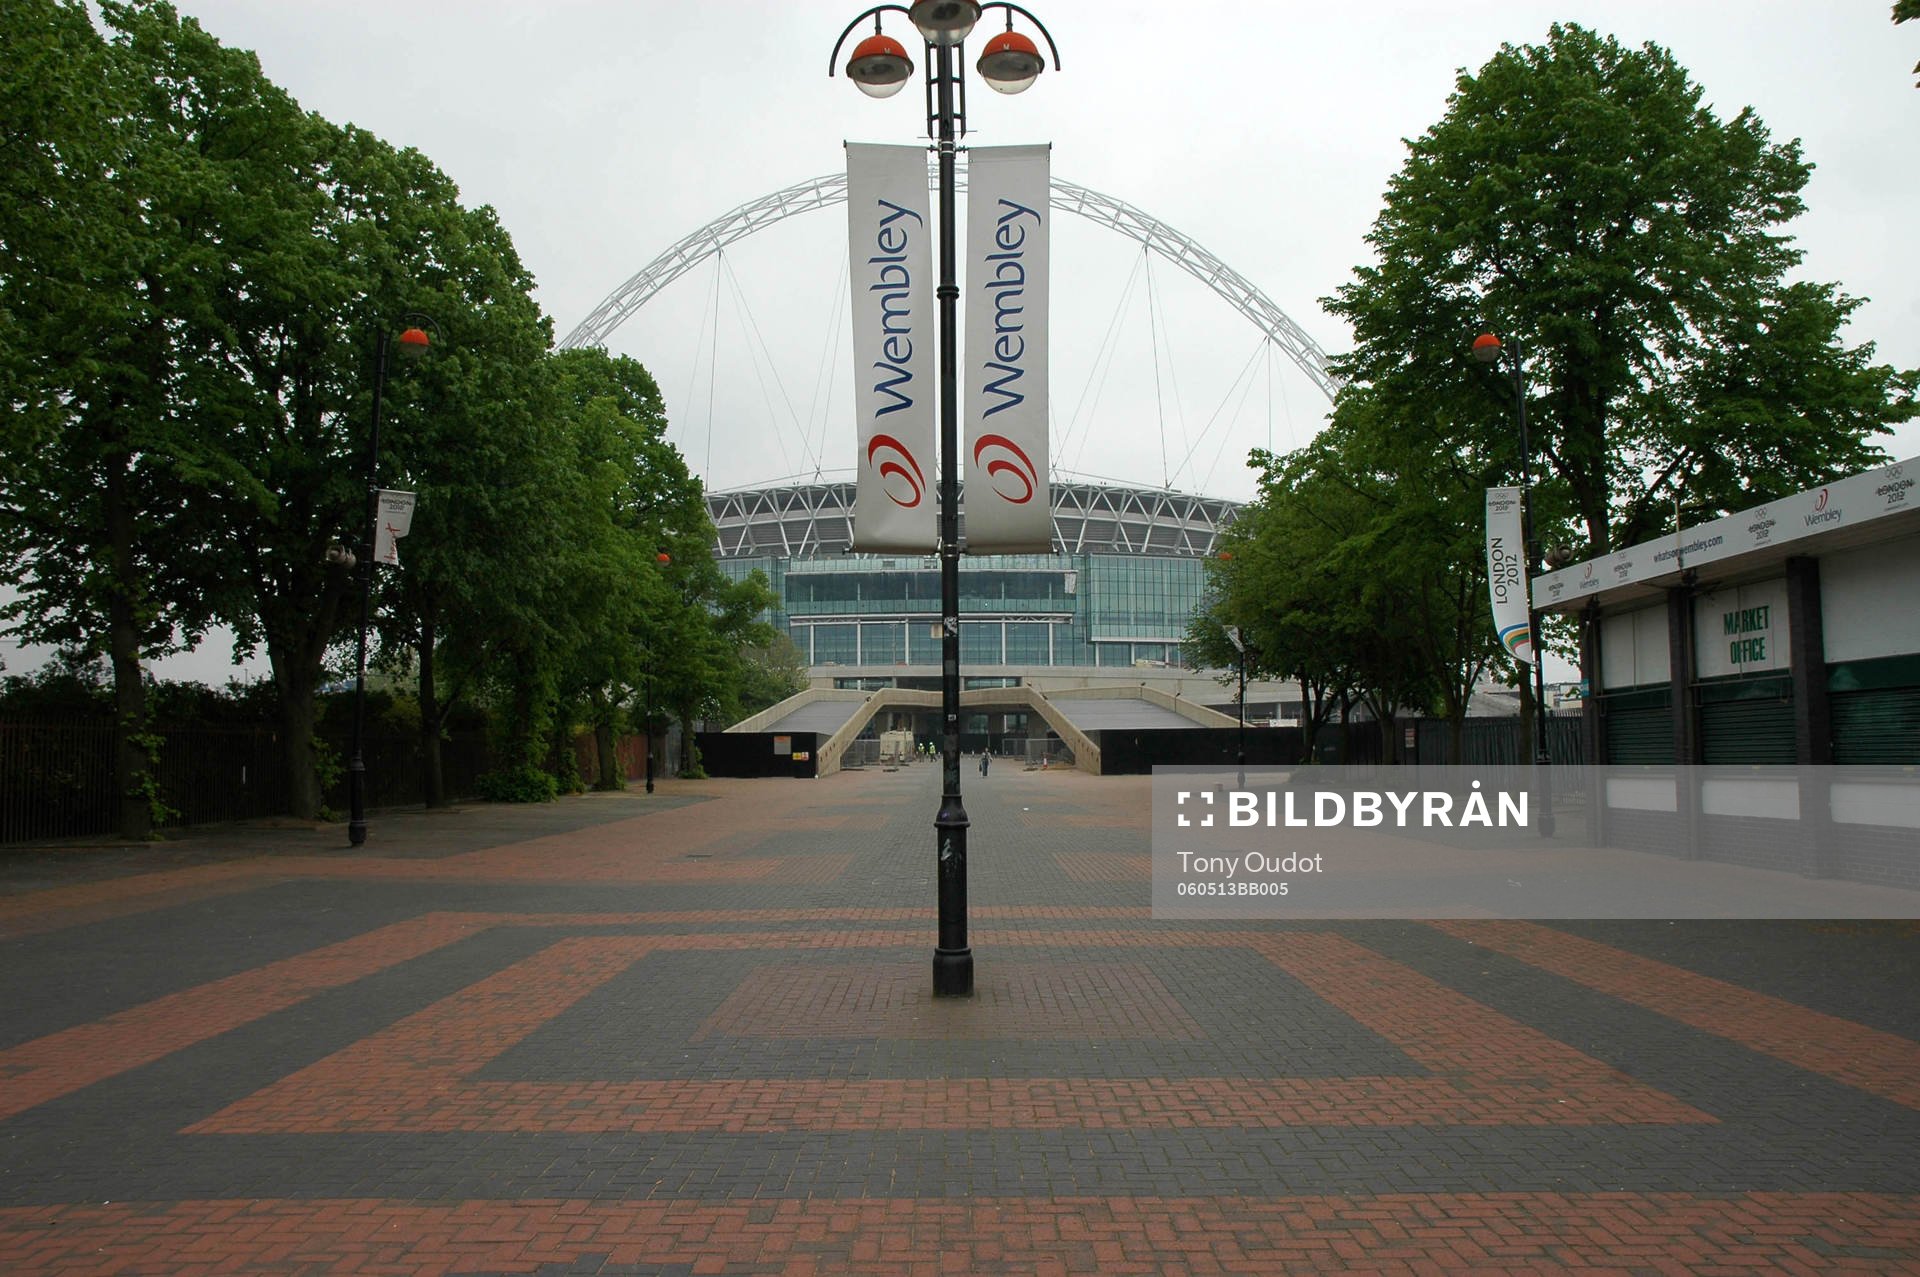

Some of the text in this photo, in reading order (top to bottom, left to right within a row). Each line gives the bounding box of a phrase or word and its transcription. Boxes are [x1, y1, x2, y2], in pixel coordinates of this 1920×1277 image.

[868, 199, 923, 419] Wembley
[982, 198, 1041, 420] Wembley
[1875, 478, 1916, 497] LONDON
[1887, 490, 1906, 504] 2012
[1747, 519, 1776, 533] LONDON
[1803, 508, 1842, 527] Wembley
[1491, 537, 1508, 605] LONDON
[1505, 554, 1520, 587] 2012
[1723, 605, 1769, 636] MARKET
[1730, 636, 1766, 664] OFFICE
